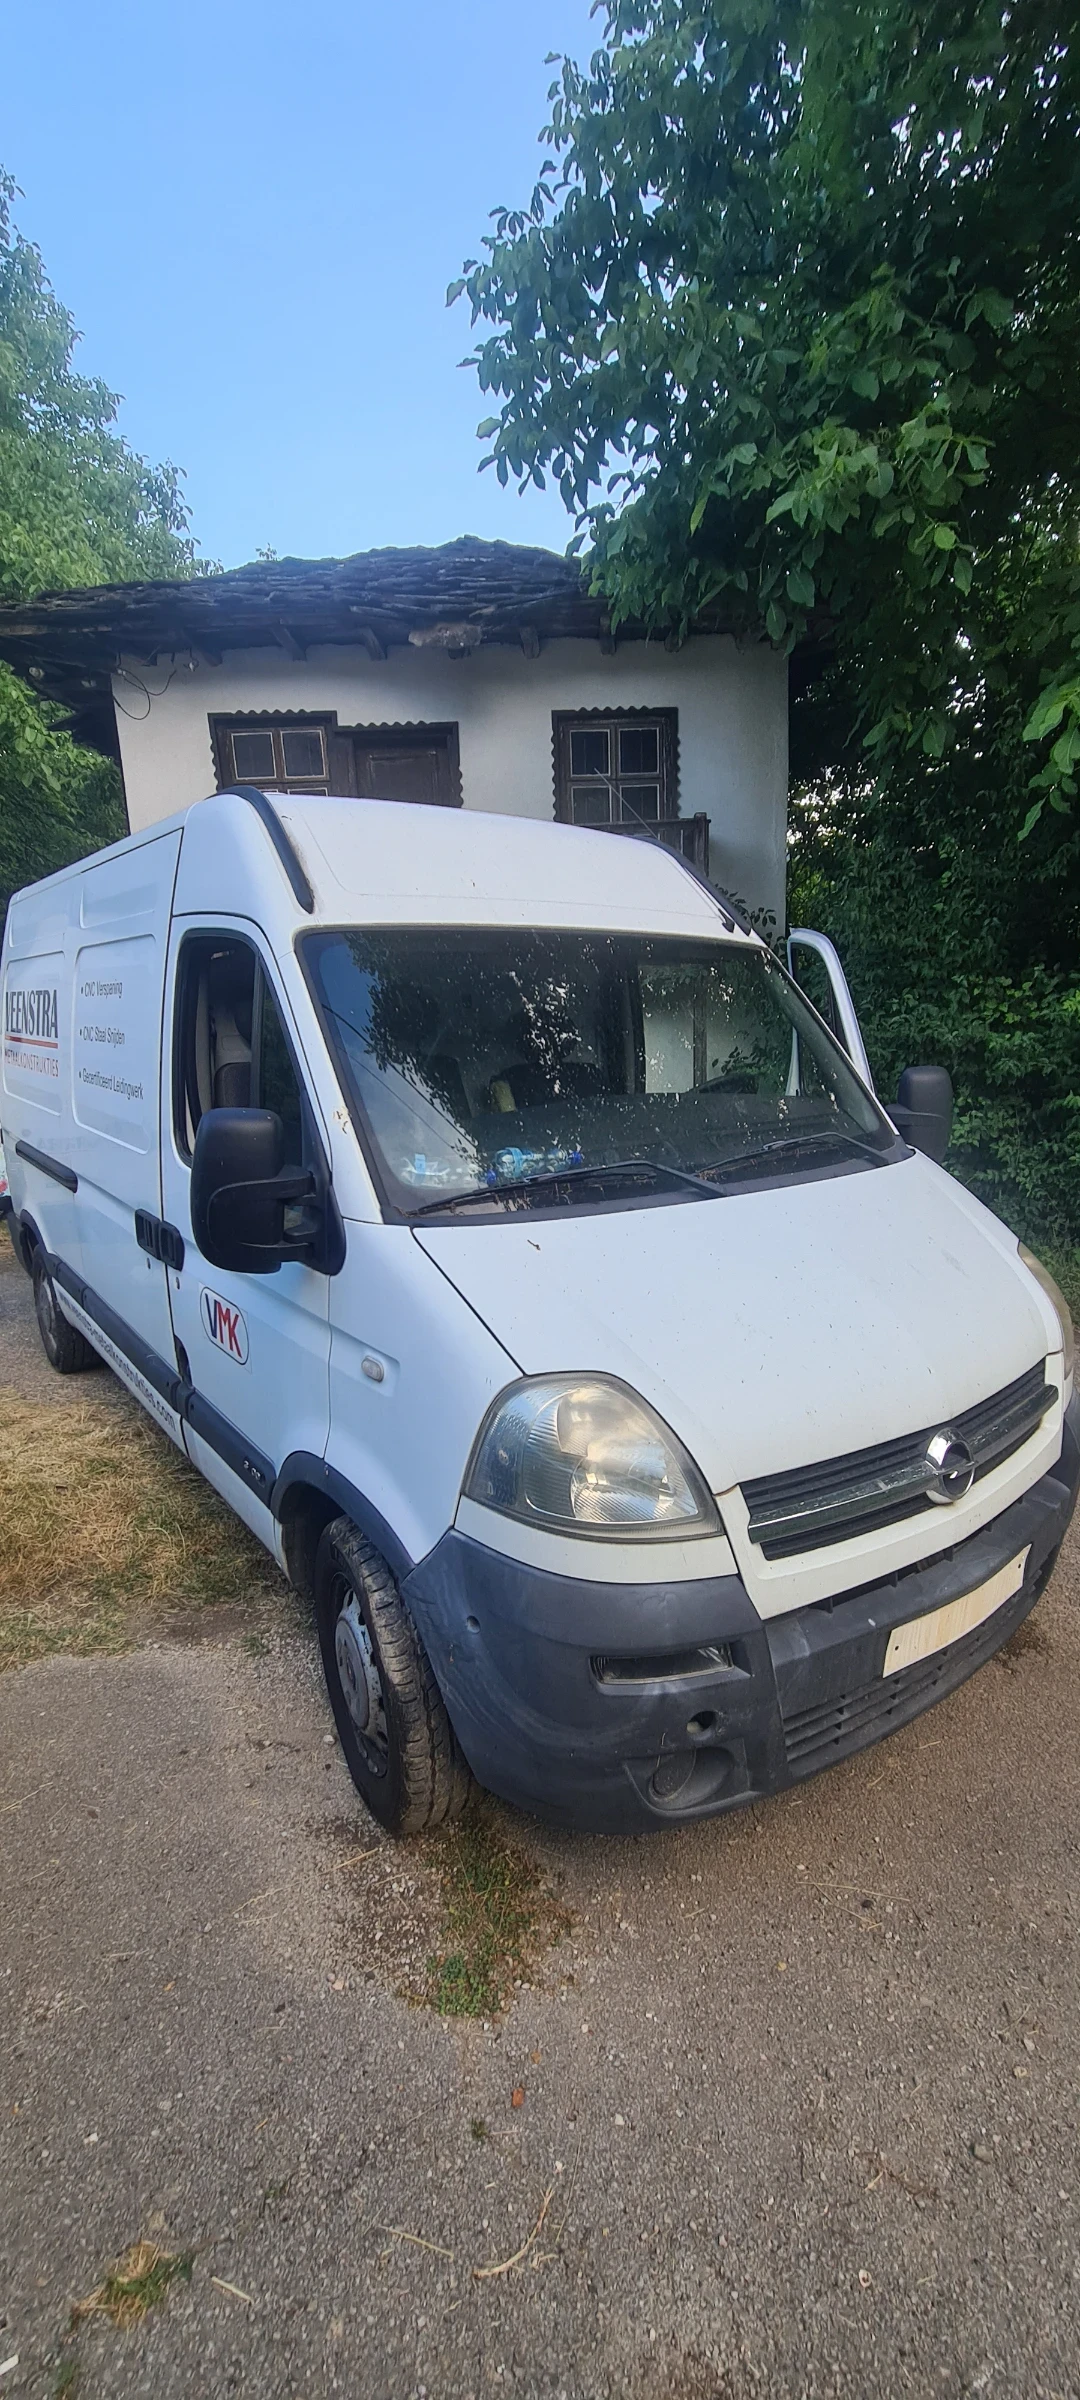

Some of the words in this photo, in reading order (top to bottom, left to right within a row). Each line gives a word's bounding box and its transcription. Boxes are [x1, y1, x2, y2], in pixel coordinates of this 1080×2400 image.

[84, 982, 95, 998] CNC
[96, 979, 122, 998] Verspaning
[83, 1027, 94, 1042] CNC
[113, 1074, 143, 1100] Leidingwerk
[205, 1293, 243, 1358] VMK
